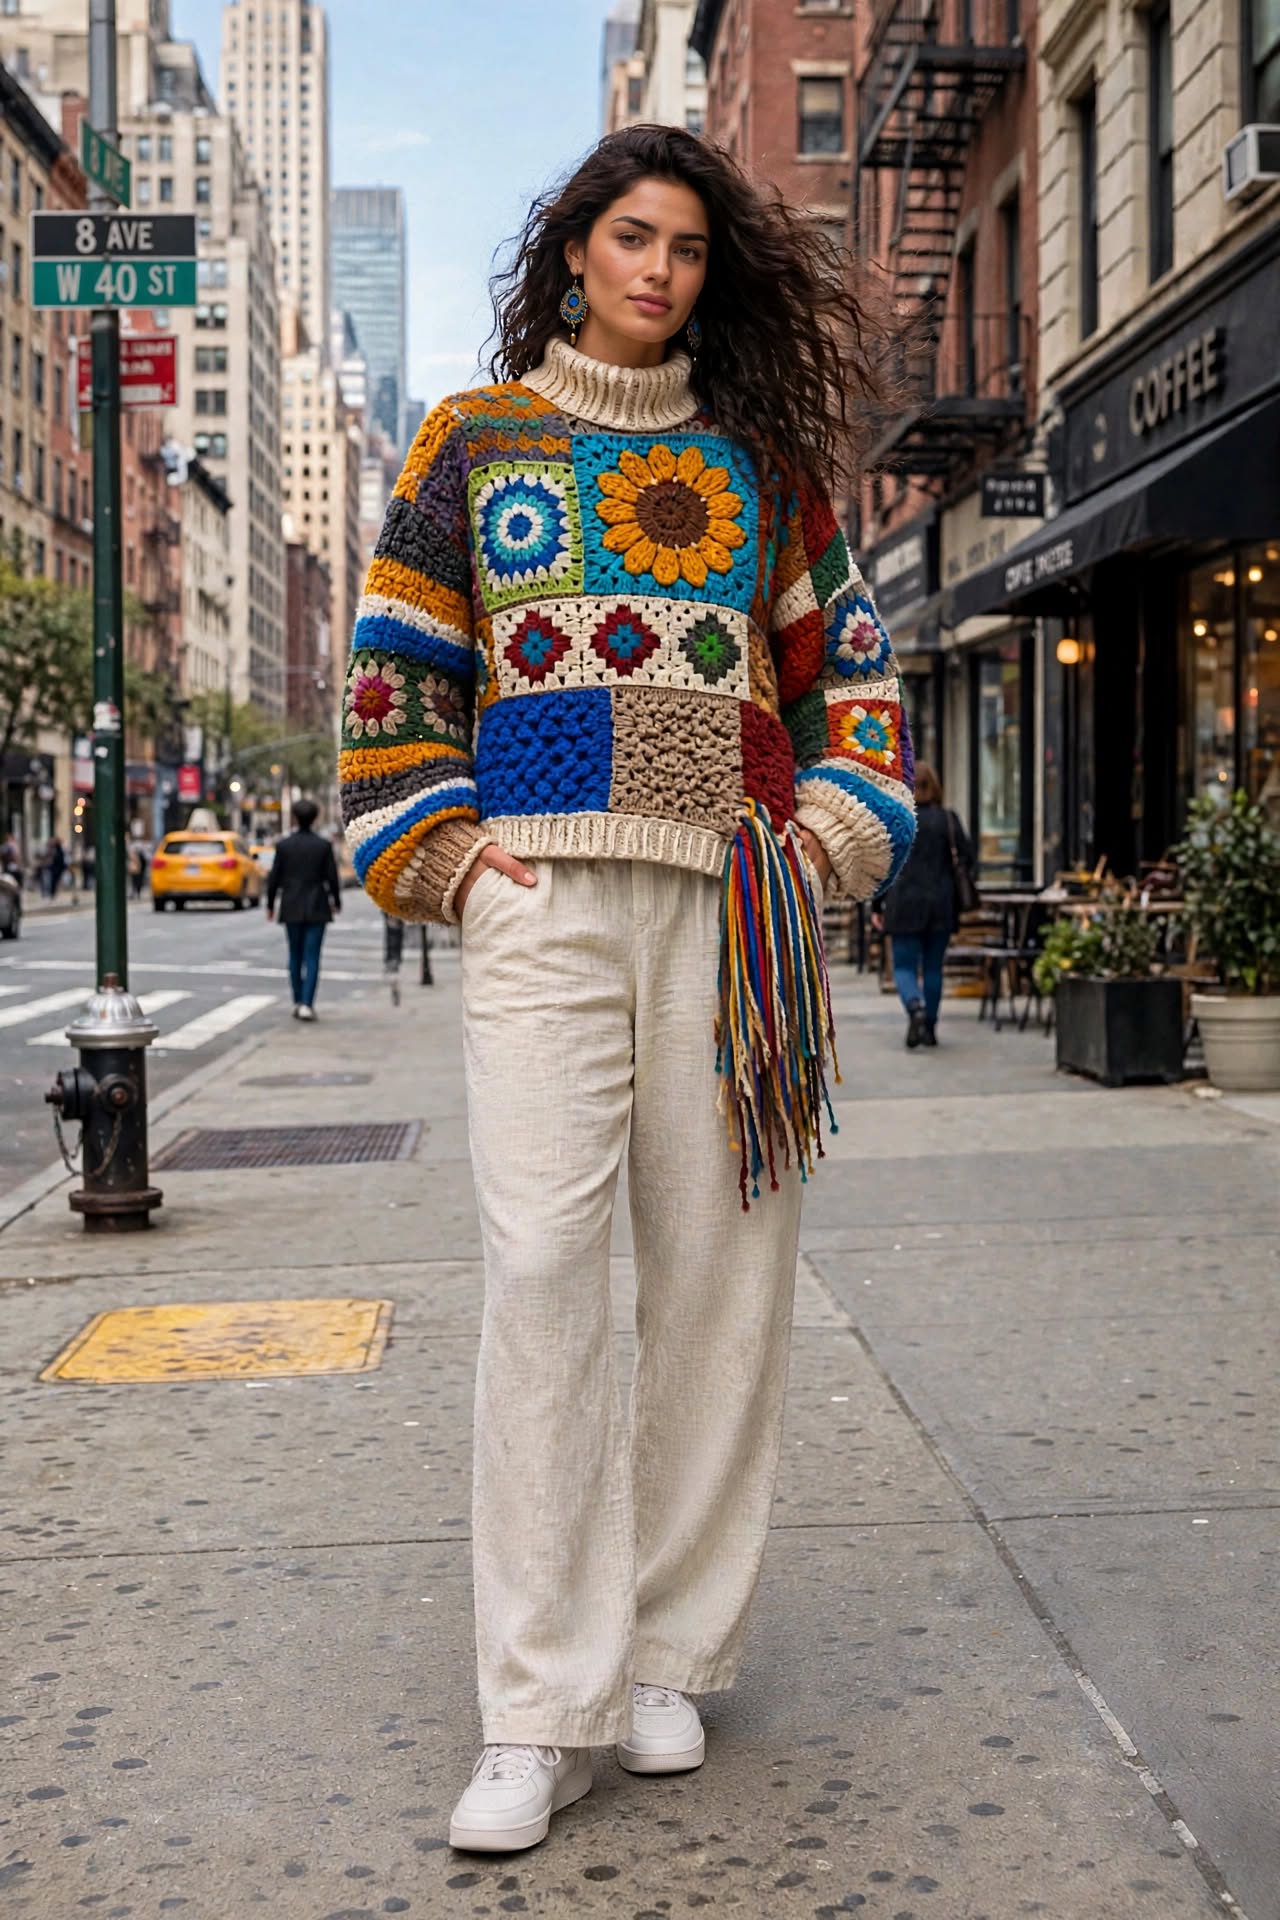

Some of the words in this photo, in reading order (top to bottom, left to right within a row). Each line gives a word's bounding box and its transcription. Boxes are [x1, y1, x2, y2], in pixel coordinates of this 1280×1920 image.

[75, 217, 97, 254] 8
[106, 220, 153, 250] AVE
[56, 263, 81, 302] W
[94, 263, 137, 303] 40
[147, 264, 176, 296] ST
[1129, 326, 1217, 436] COFFEE
